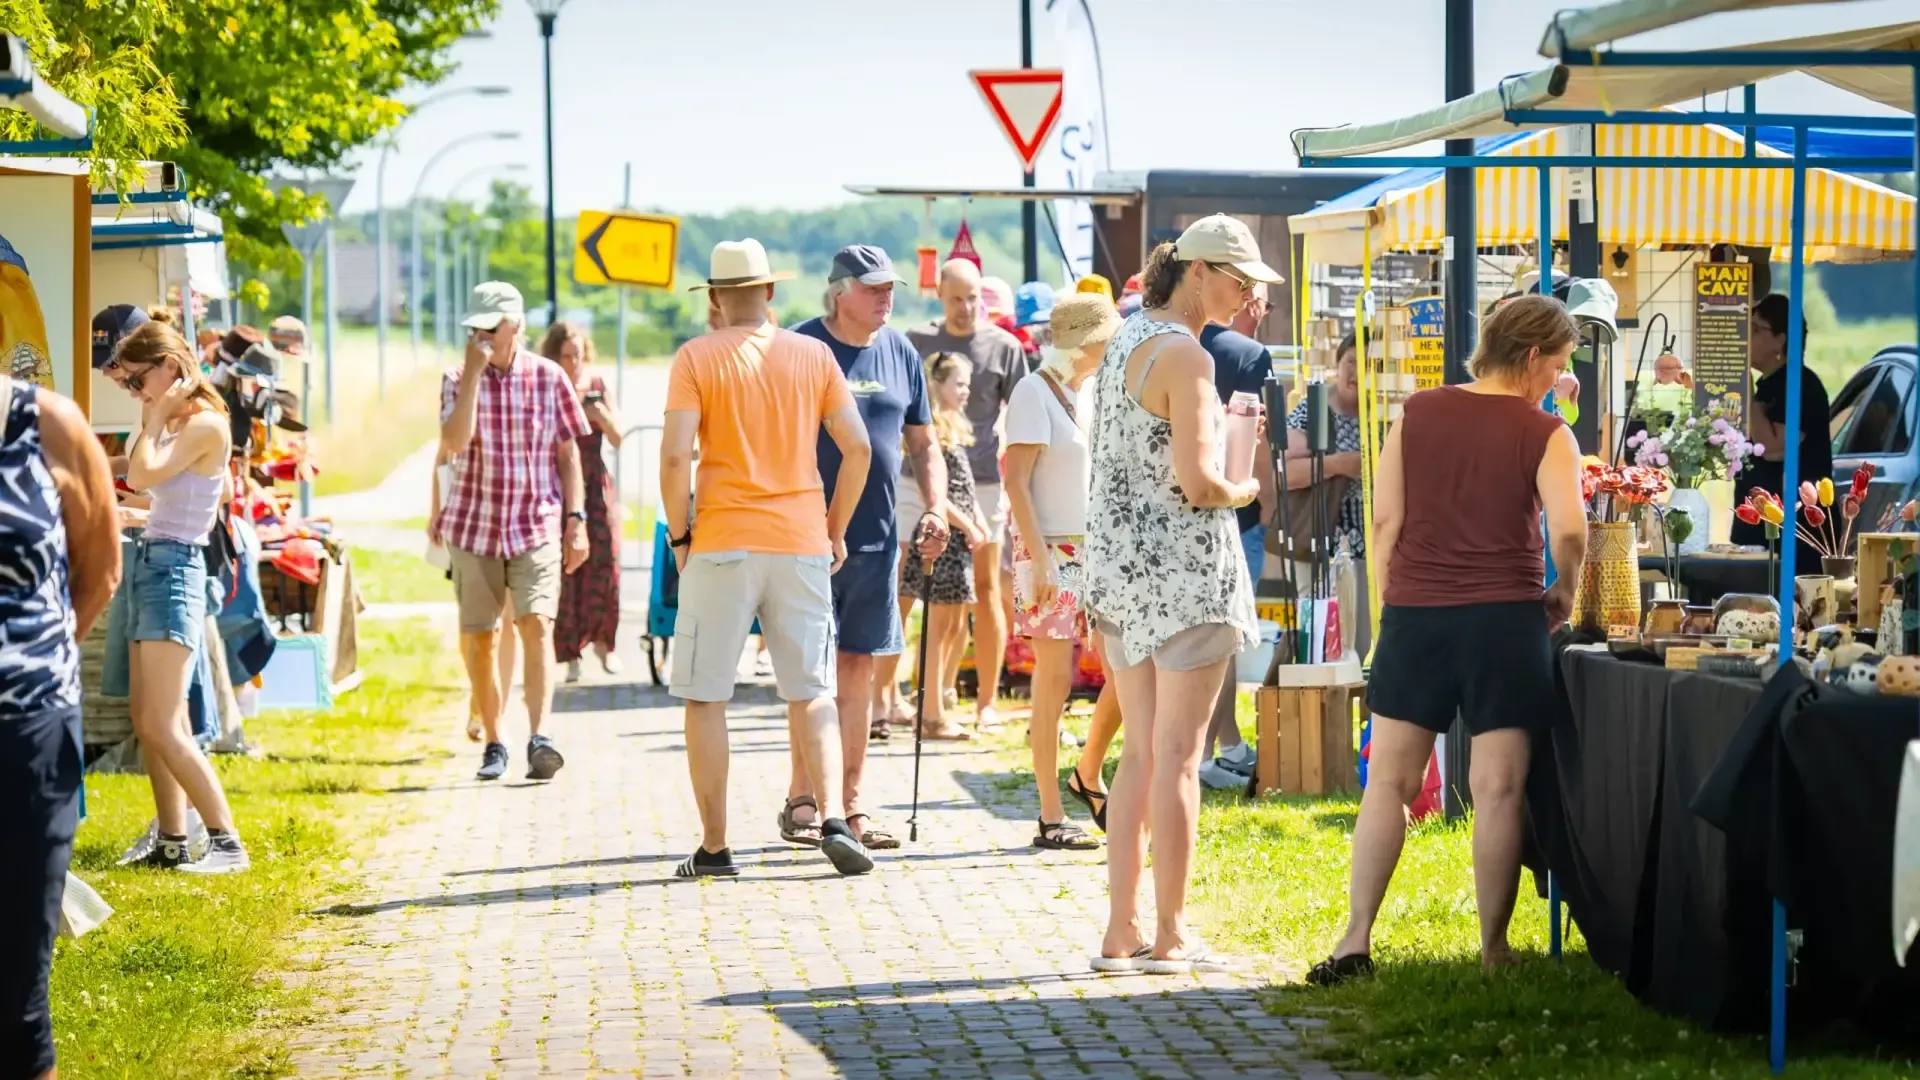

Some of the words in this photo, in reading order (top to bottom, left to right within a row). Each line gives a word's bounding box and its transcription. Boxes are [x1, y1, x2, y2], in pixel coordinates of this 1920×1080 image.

[1698, 266, 1748, 281] MAN
[1698, 281, 1748, 296] CAVE
[1420, 340, 1433, 350] HE
[1423, 364, 1444, 374] REMI
[1416, 378, 1433, 388] ERY
